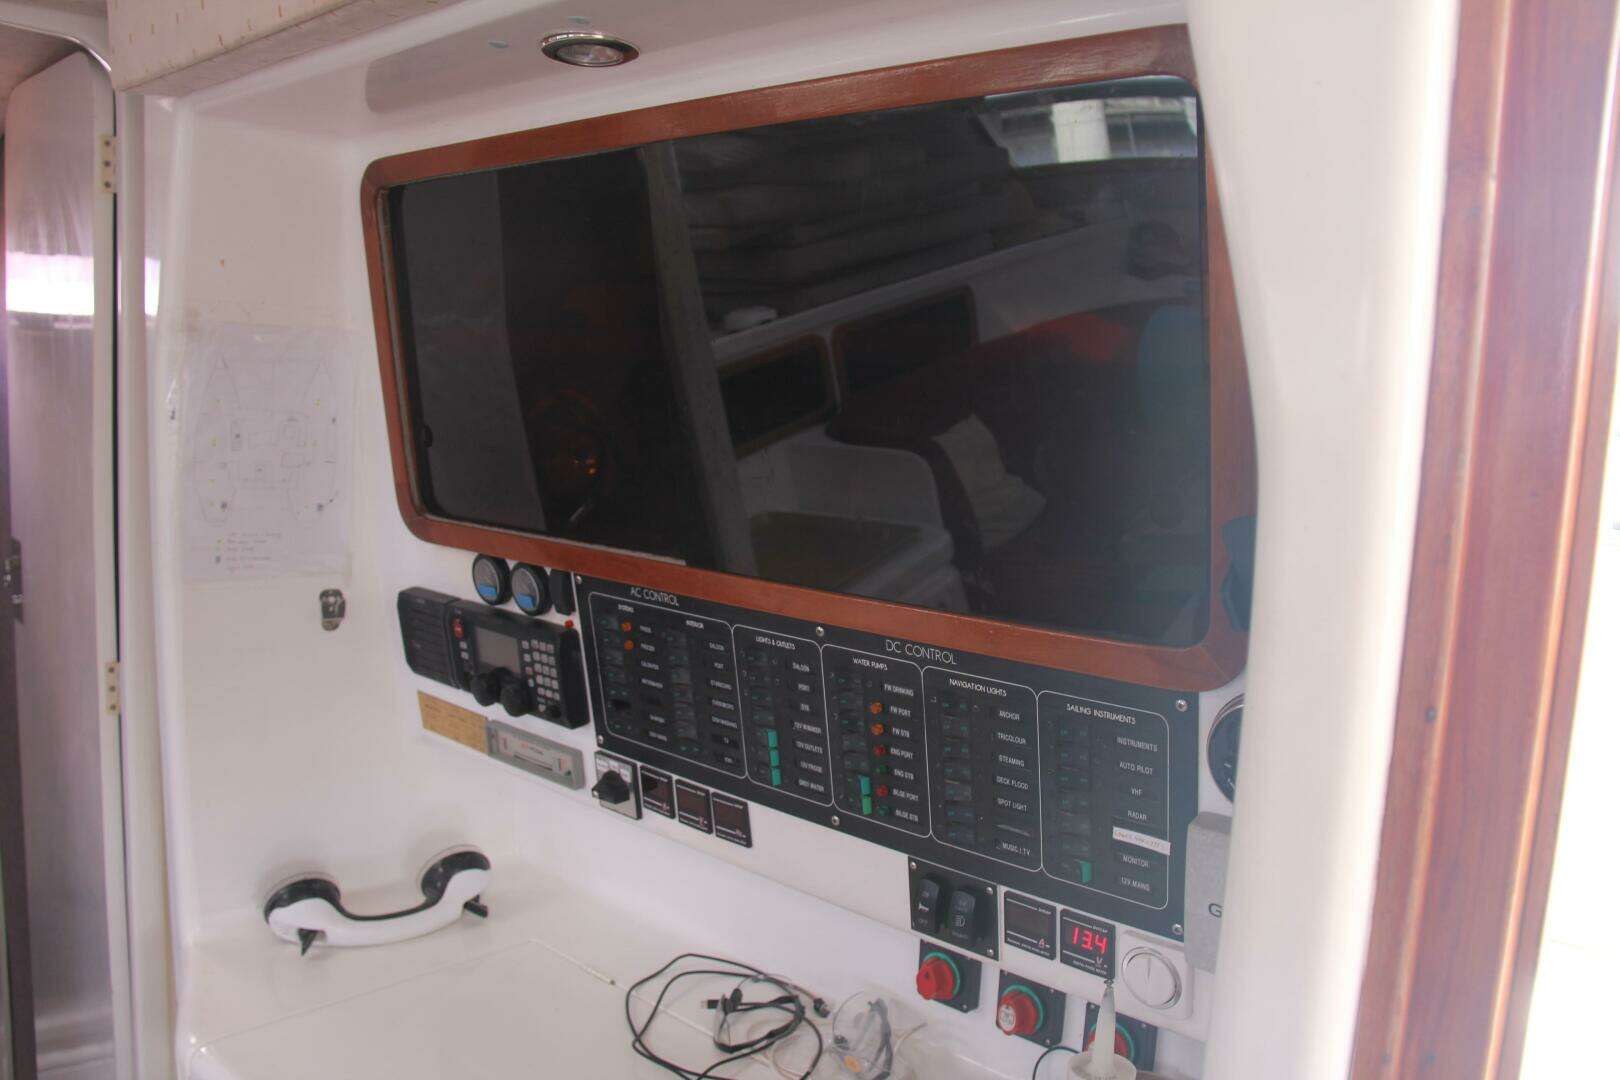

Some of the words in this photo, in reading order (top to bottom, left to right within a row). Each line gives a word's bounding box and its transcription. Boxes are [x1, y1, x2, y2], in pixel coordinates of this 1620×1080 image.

[631, 587, 641, 598] AC
[643, 588, 680, 607] CONTROL
[885, 639, 901, 654] DC
[904, 643, 957, 665] CONTROL
[853, 658, 870, 668] WATER
[871, 661, 888, 671] PUMPS
[949, 678, 986, 694] NAVIGATION
[986, 686, 1007, 697] LIGHTS
[999, 710, 1021, 721] ANCHOR
[1066, 703, 1092, 716] SAILING
[1093, 709, 1136, 725] INSTRUMENTS
[1116, 737, 1158, 752] INSTRUMENTS
[999, 755, 1025, 768] STEAMING
[1119, 761, 1135, 773] AUTO
[1136, 764, 1154, 776] PILOT
[1131, 788, 1143, 797] VHF
[1127, 810, 1148, 821] RADAR
[1122, 855, 1149, 868] MONITOR
[1072, 927, 1108, 954] 13.4
